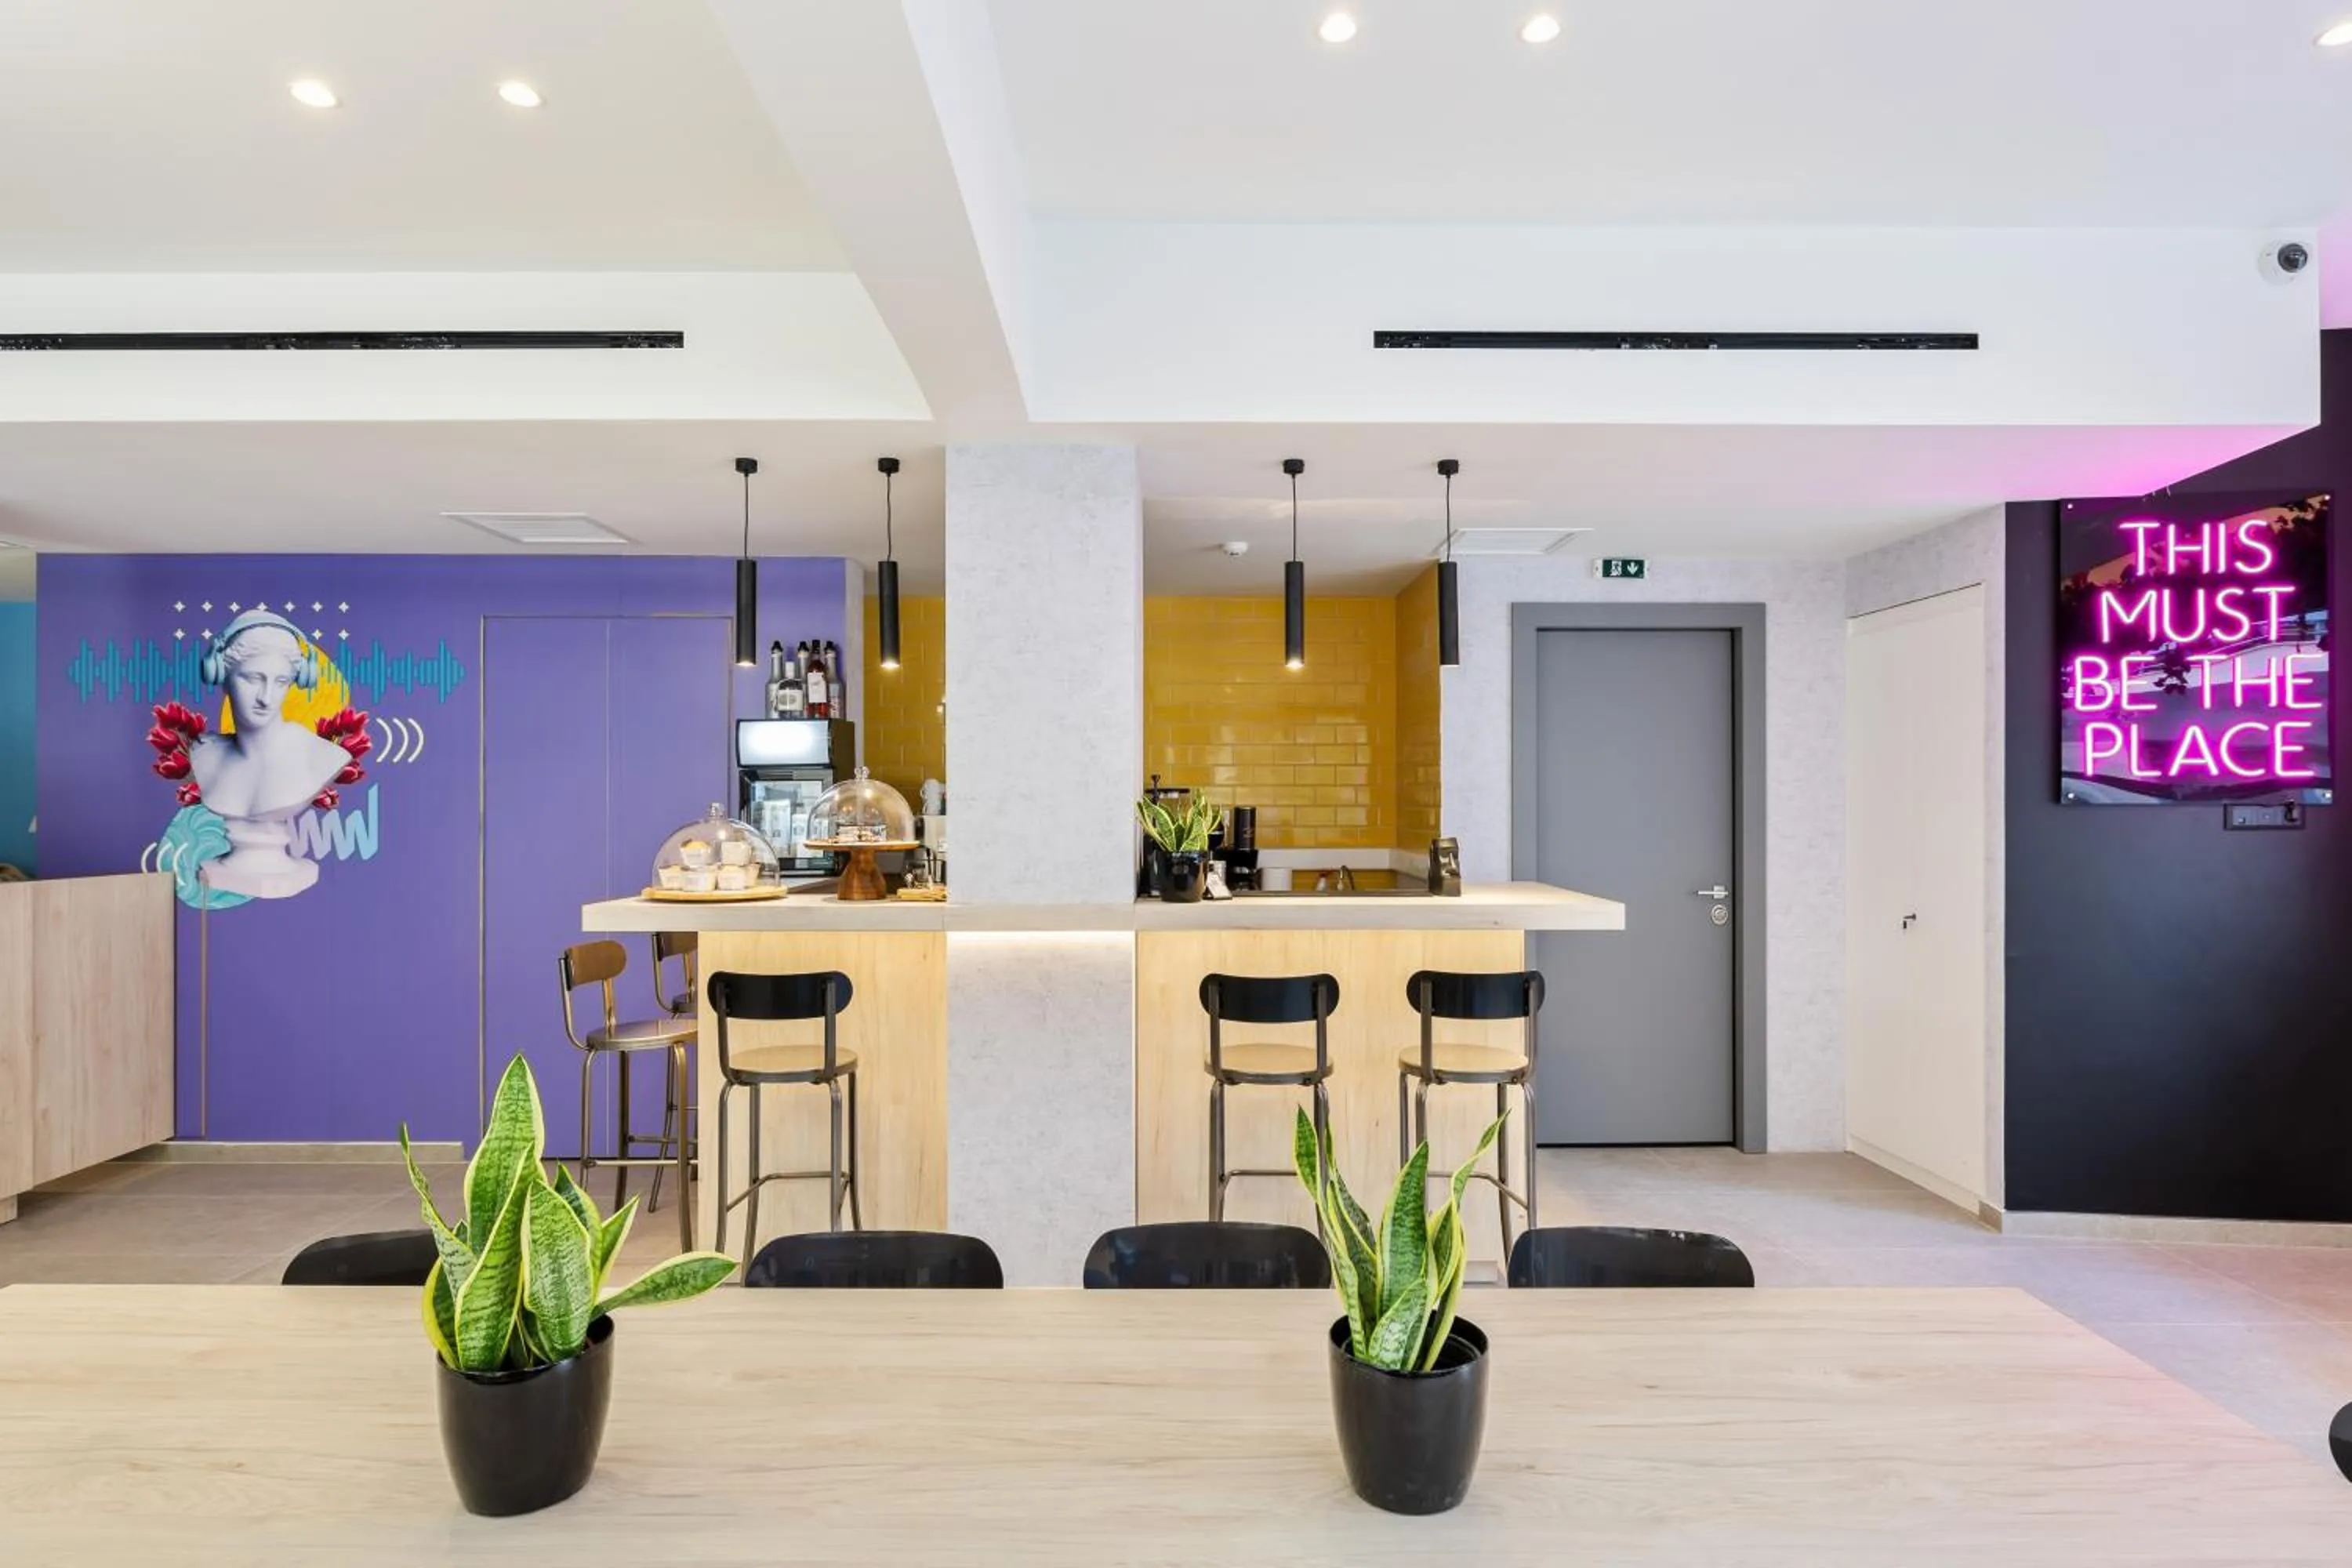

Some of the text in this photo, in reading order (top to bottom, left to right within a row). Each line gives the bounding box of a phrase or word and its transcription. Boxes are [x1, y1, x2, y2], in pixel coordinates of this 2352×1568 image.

[2119, 520, 2273, 575] THIS
[2101, 586, 2296, 643] MUST
[2074, 653, 2325, 711] BE THE
[2084, 721, 2315, 777] PLACE
